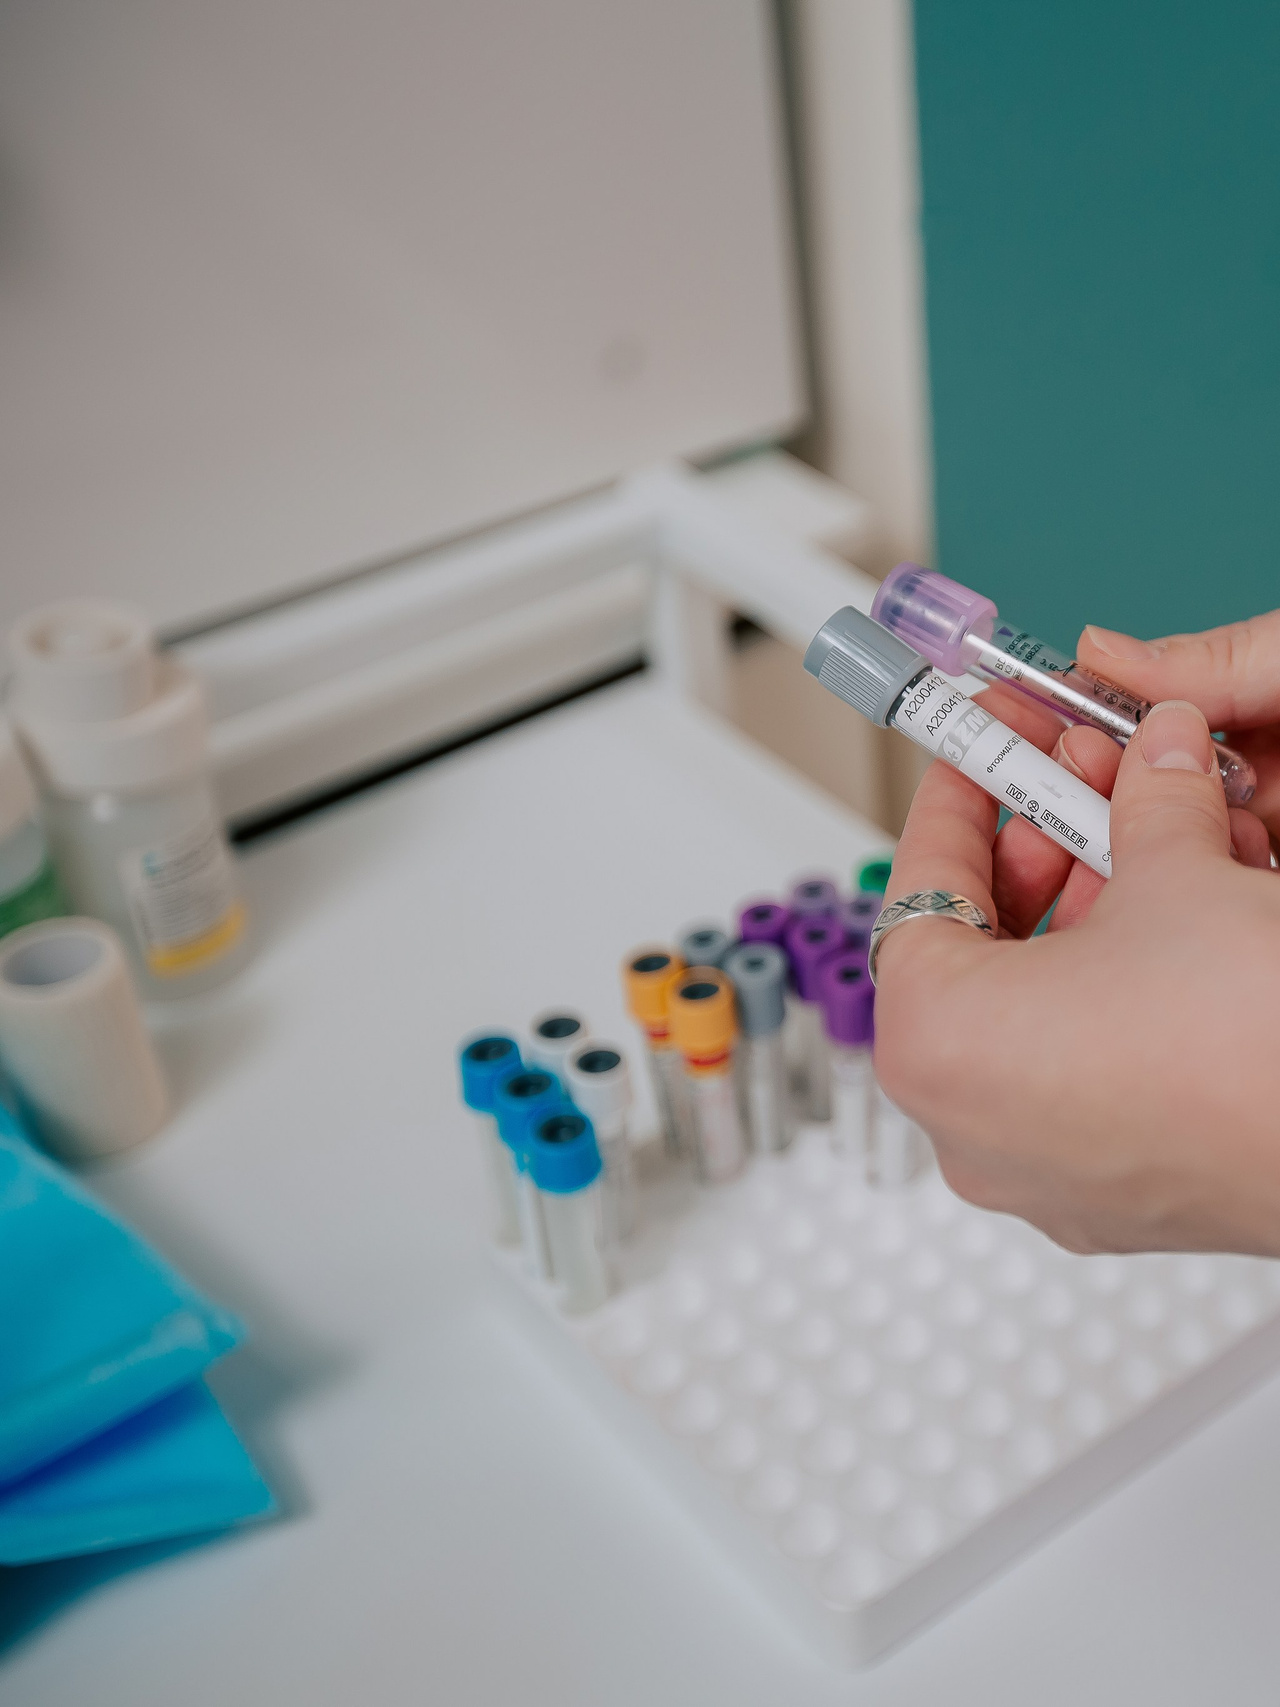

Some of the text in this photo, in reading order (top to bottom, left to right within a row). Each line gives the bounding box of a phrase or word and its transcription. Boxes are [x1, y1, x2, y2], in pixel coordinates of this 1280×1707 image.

[1051, 692, 1079, 712] Company
[986, 735, 1022, 773] Фторид/ЭД
[1009, 786, 1023, 800] IVD
[1044, 812, 1076, 840] STERILE
